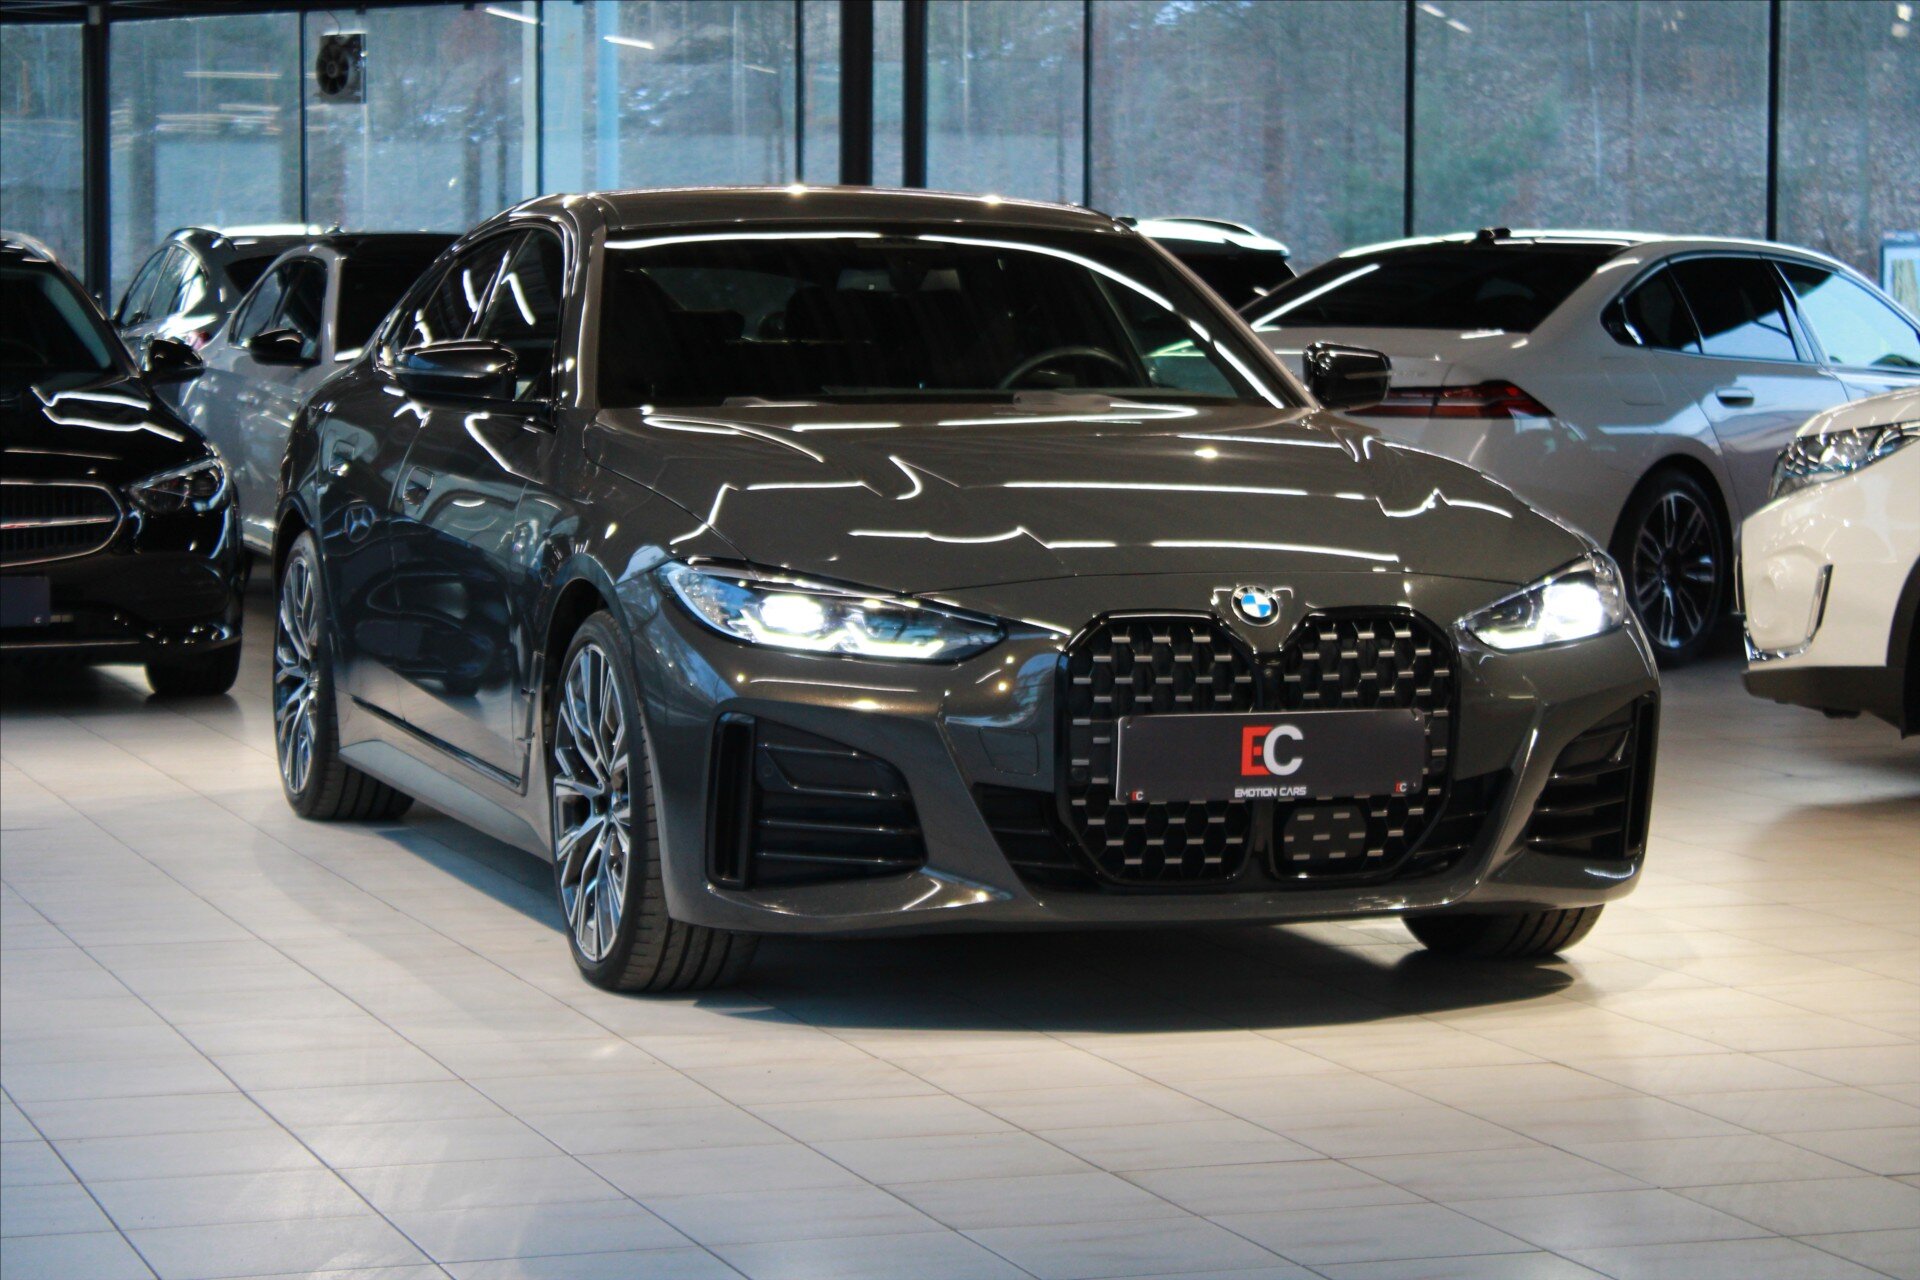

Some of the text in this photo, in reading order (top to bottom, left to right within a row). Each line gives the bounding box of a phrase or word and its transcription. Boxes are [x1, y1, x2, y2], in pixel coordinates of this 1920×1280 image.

[1241, 725, 1304, 776] EC
[1234, 786, 1307, 798] EMOTION CARS
